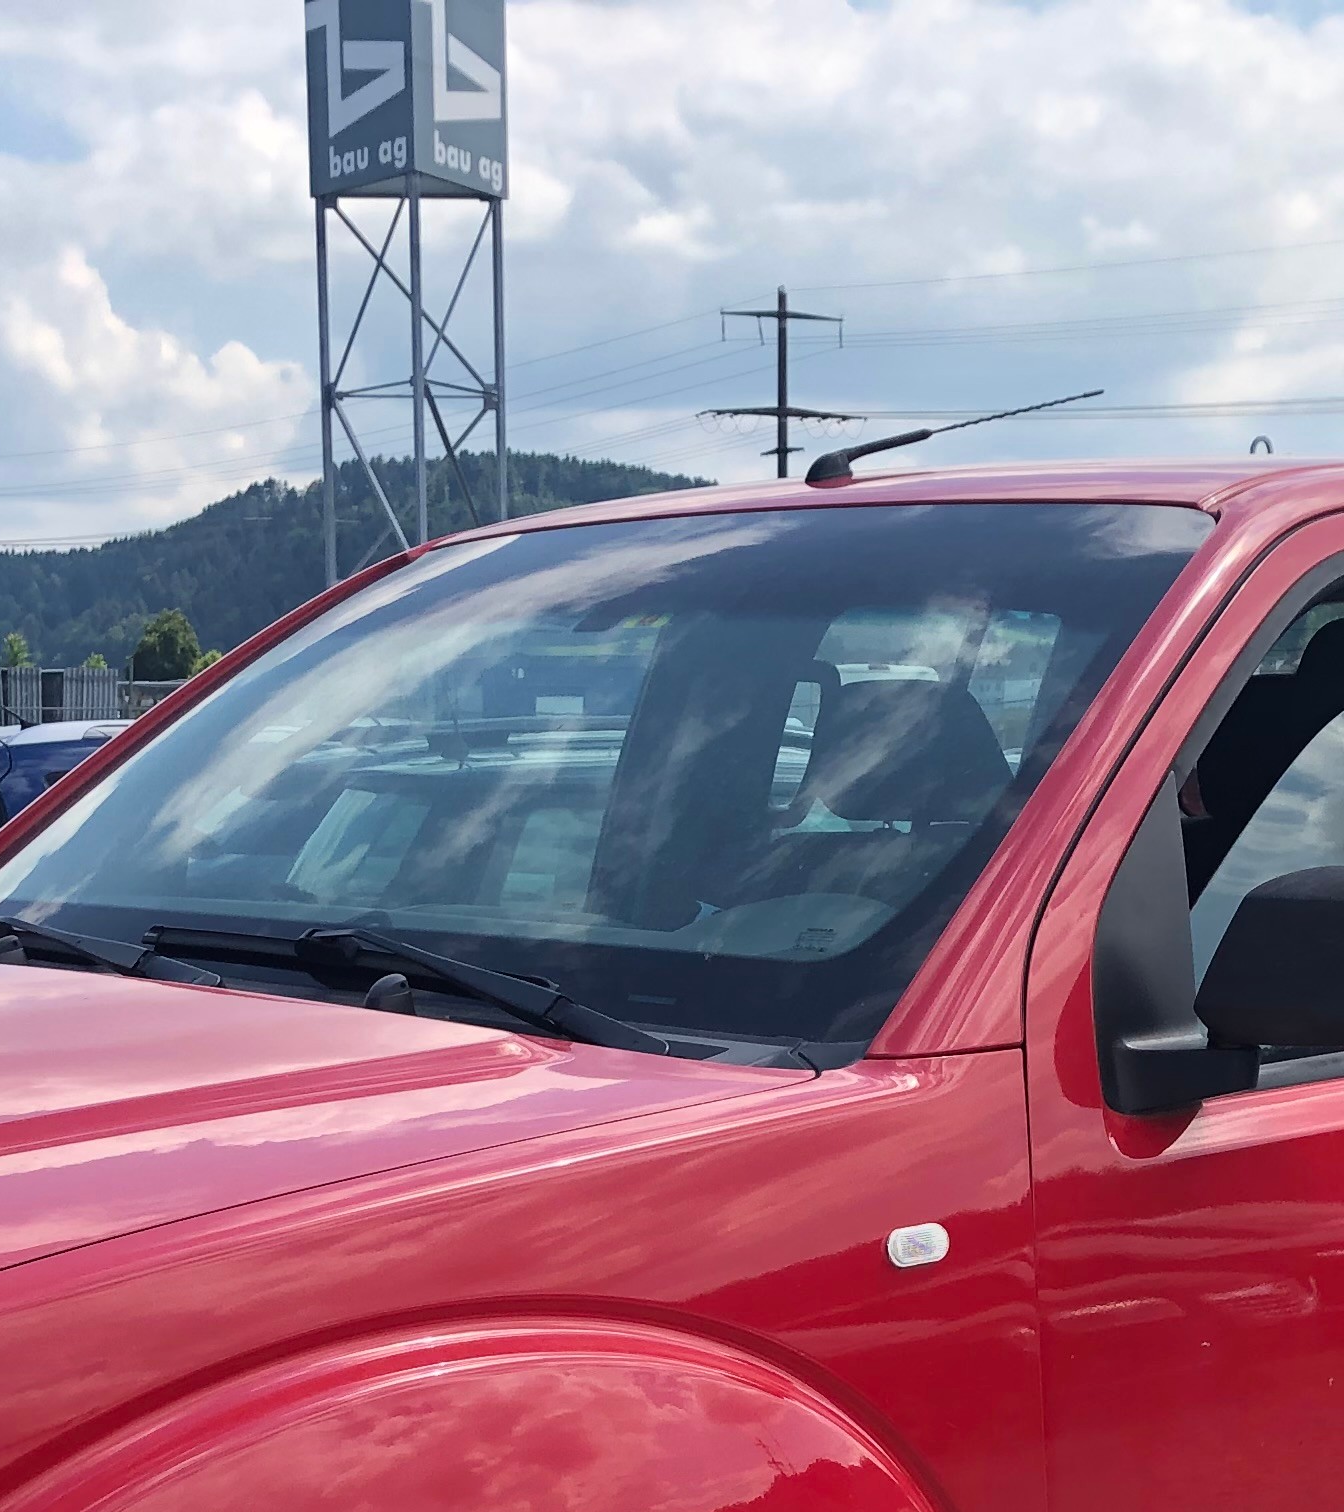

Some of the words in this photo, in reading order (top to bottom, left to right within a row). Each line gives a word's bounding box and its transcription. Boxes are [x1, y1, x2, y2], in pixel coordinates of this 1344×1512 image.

[329, 146, 369, 179] bau
[378, 136, 407, 169] ag
[433, 129, 472, 174] bau
[478, 155, 503, 192] ag
